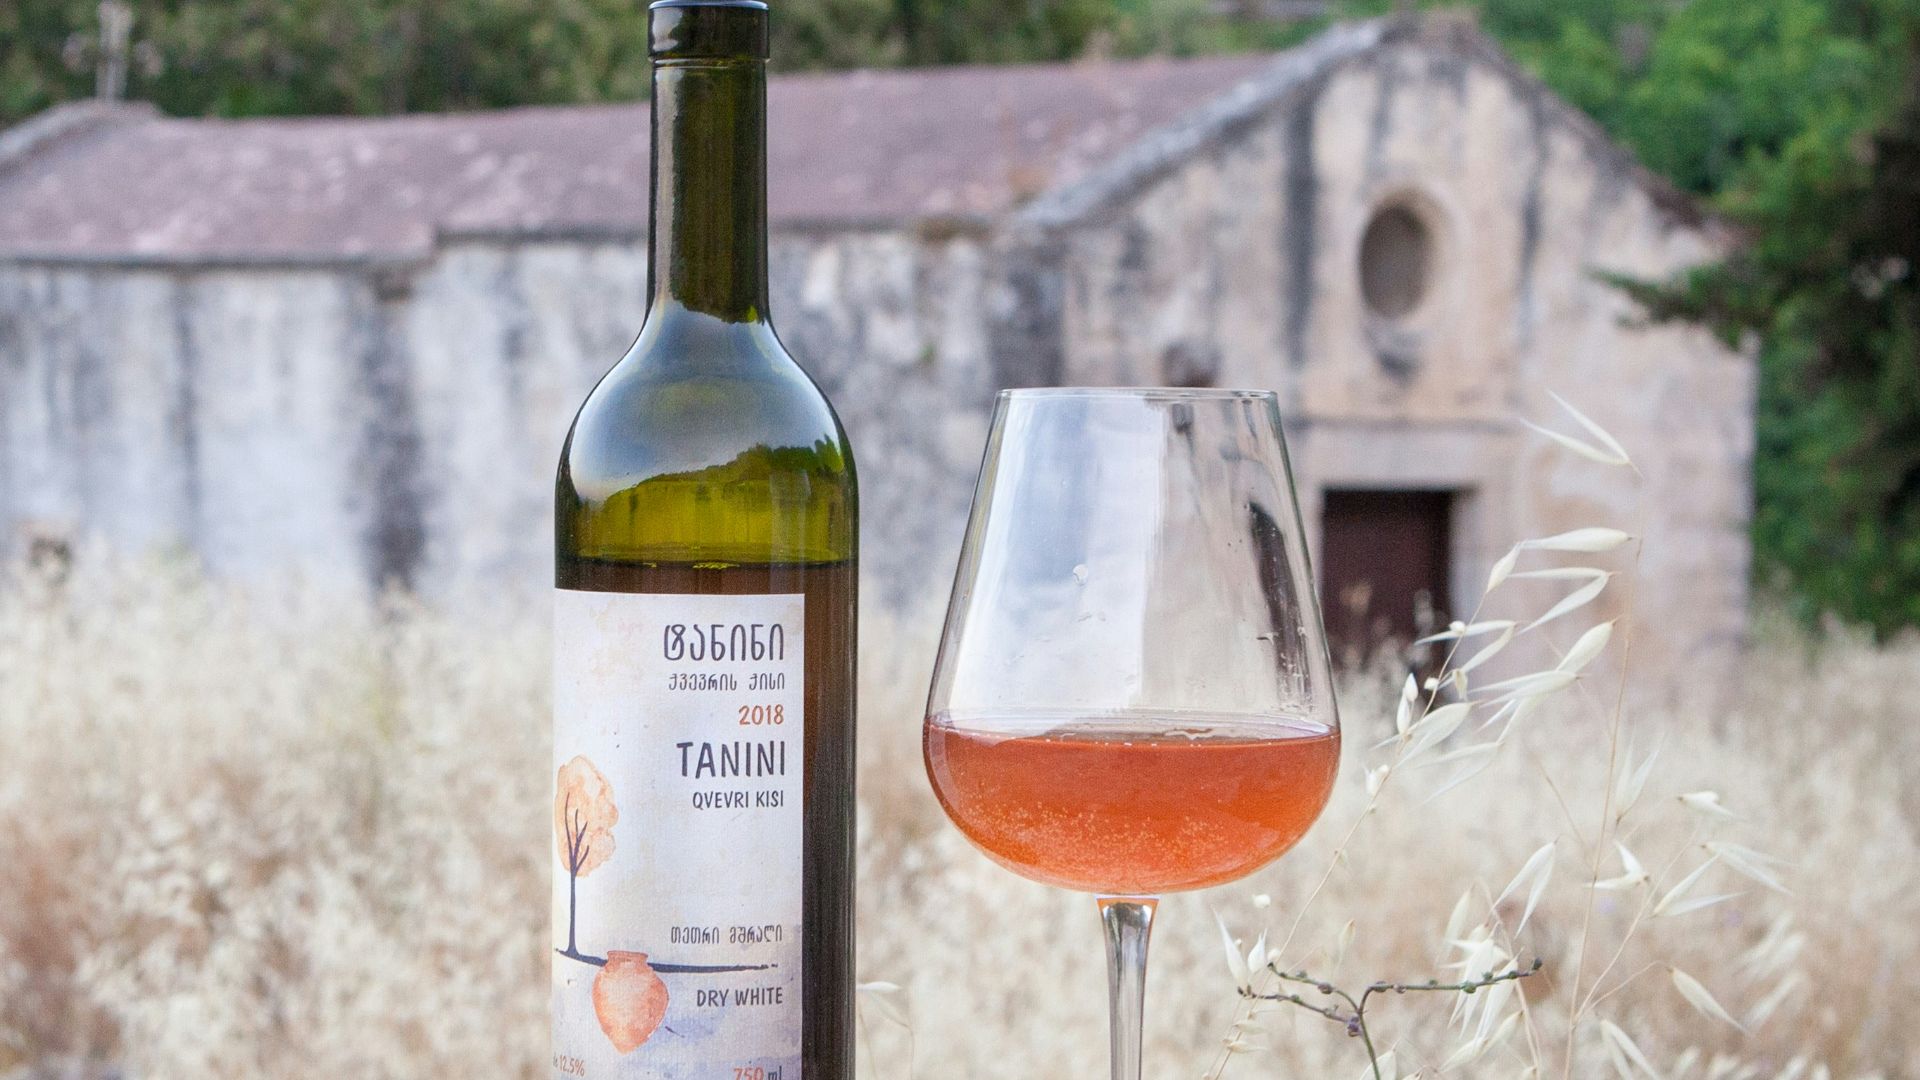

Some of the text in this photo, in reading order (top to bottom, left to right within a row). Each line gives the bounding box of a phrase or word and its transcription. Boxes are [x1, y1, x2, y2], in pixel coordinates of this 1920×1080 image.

[663, 623, 784, 662] ტანინი
[668, 672, 785, 691] ქვევრის ქისი
[738, 704, 785, 725] 2018
[676, 740, 785, 779] TANINI
[692, 790, 784, 810] QVEVRI KISI
[670, 924, 783, 944] თეთრი მშრალი
[696, 986, 783, 1007] DRY WHITE
[768, 1065, 782, 1080] ml
